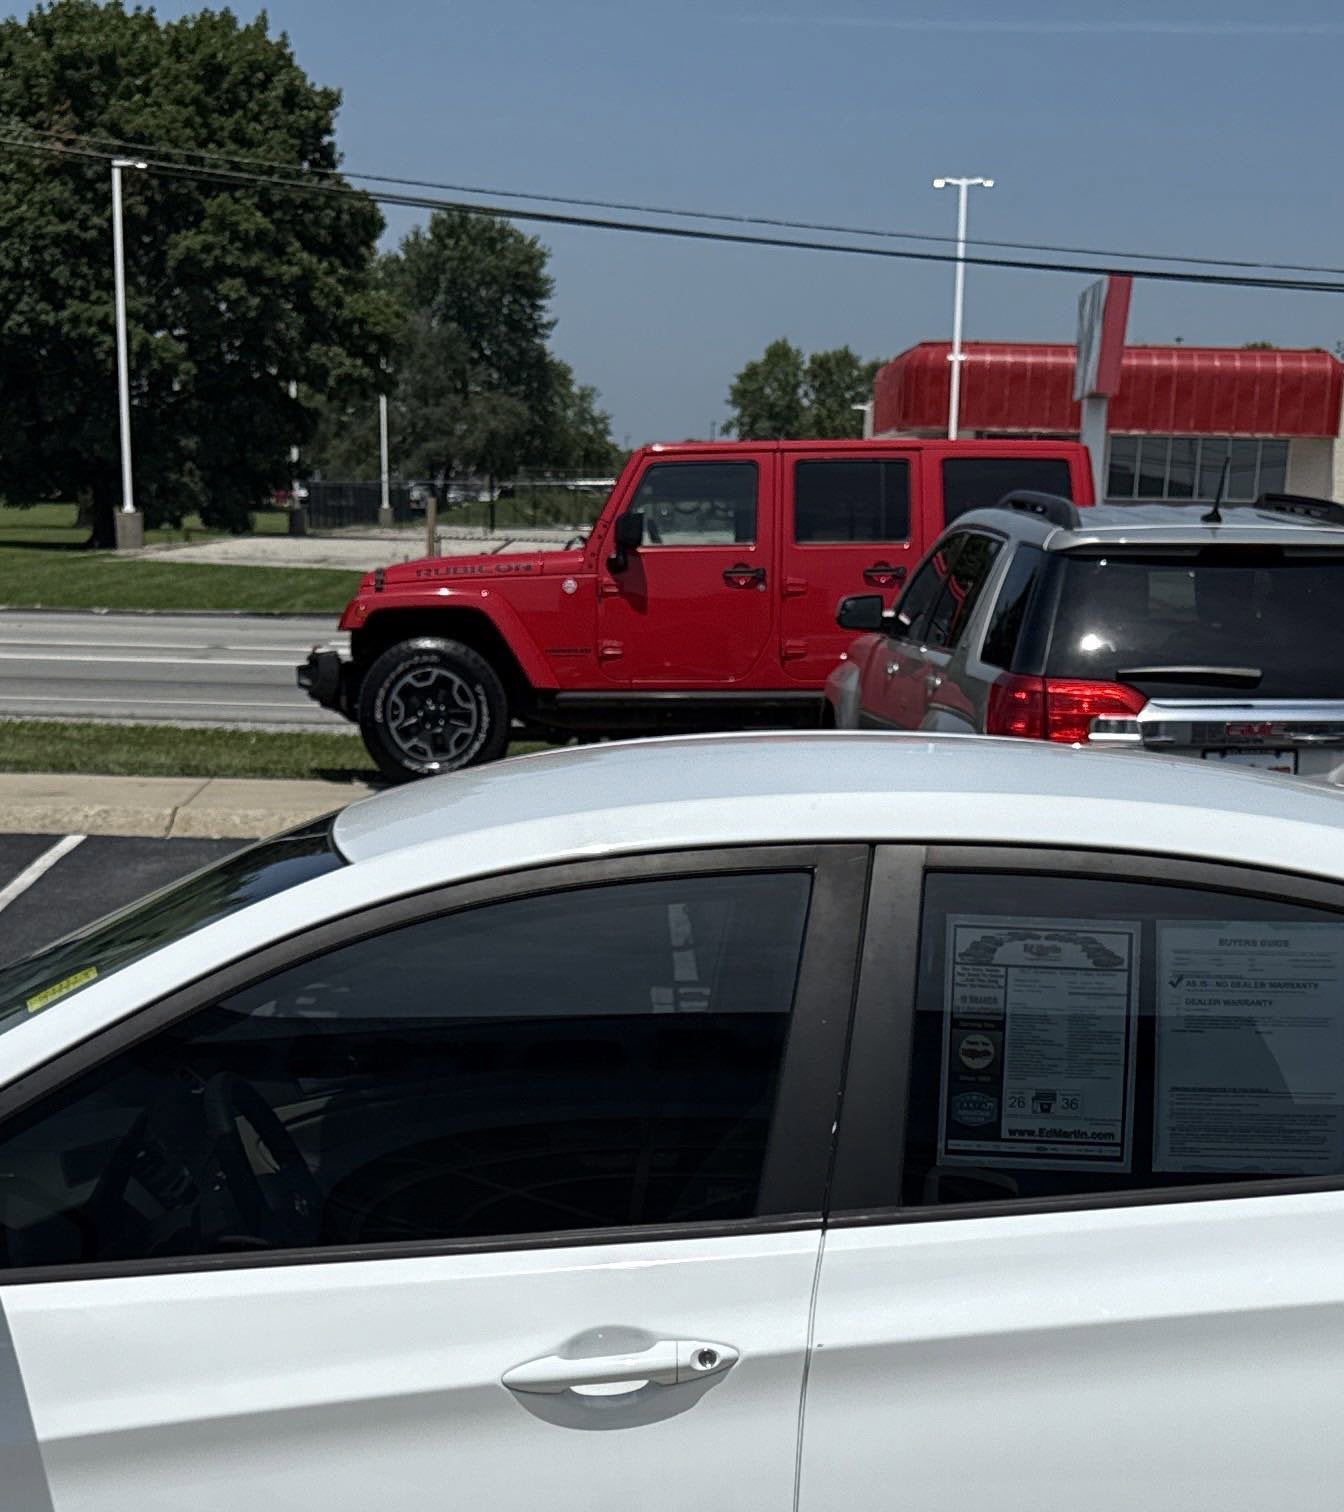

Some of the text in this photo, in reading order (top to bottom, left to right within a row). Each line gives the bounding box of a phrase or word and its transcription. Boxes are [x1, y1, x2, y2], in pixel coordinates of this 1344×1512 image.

[416, 563, 532, 577] RUBICON
[1007, 1096, 1026, 1109] 26
[1061, 1097, 1079, 1111] 36
